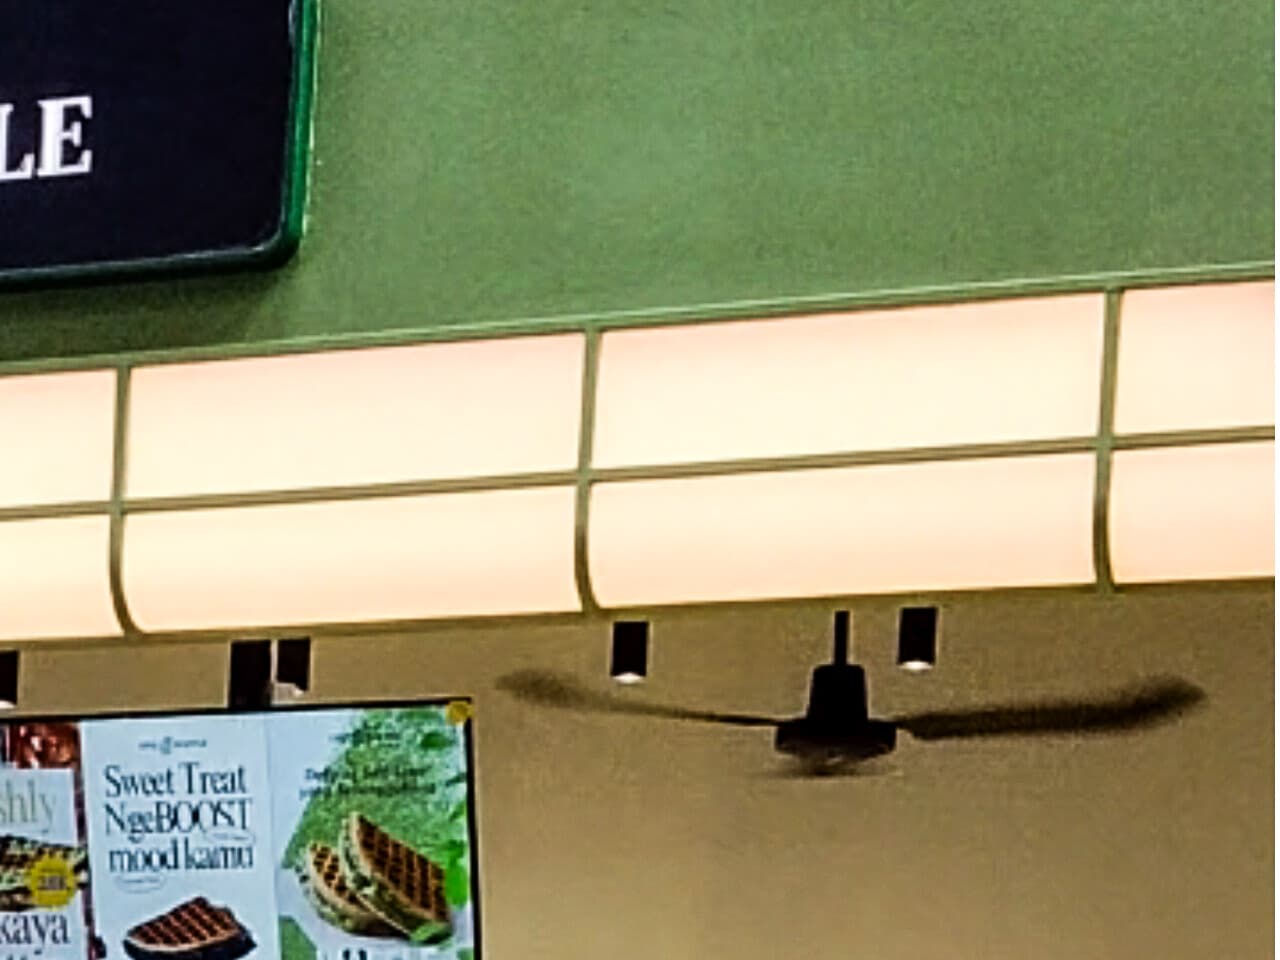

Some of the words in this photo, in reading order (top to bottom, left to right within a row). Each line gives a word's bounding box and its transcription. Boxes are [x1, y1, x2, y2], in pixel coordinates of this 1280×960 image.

[105, 764, 175, 798] Sweet
[178, 761, 246, 795] Treat
[105, 798, 253, 843] NgeBOOST
[109, 836, 179, 872] mood
[184, 836, 253, 870] kamu
